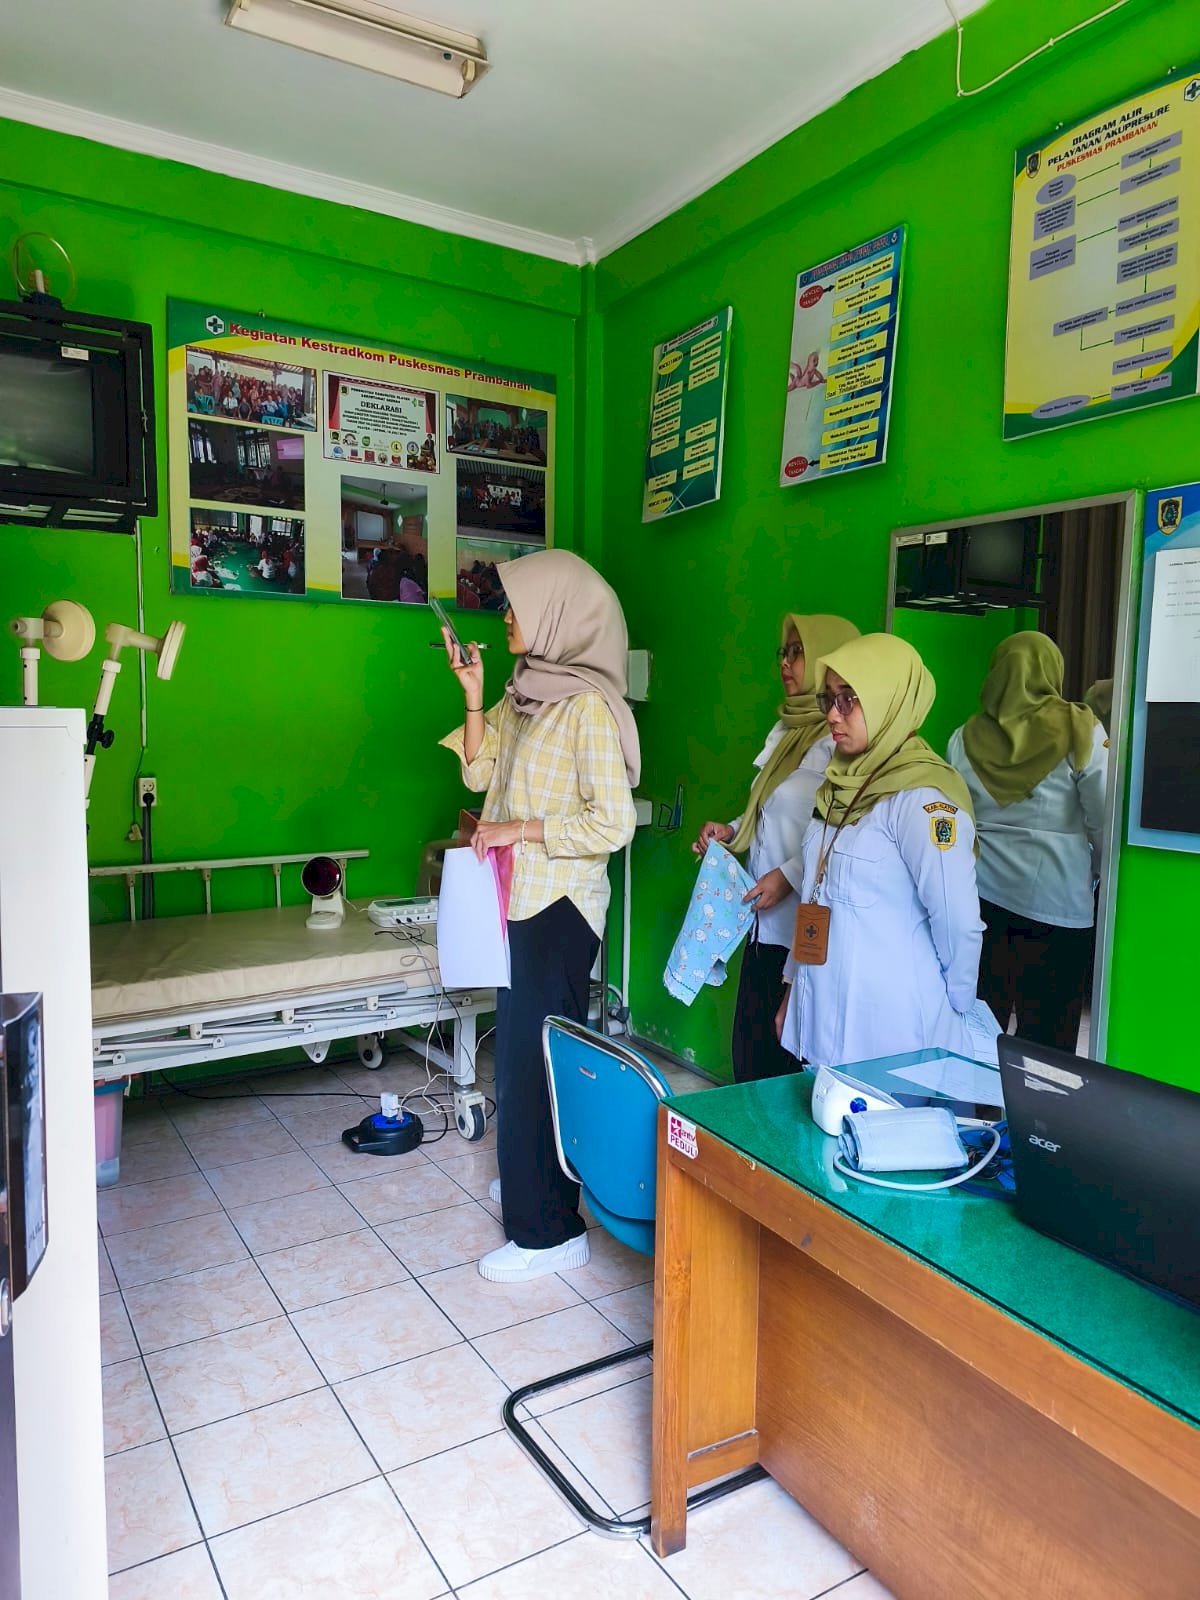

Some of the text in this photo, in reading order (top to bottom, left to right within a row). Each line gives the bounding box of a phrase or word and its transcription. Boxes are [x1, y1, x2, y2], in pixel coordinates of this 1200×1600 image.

[1048, 138, 1102, 167] PELAYANAN
[1104, 104, 1170, 141] AKUPRESURE
[1056, 143, 1103, 172] PUSKESMAS
[1105, 120, 1159, 150] PRAMBANAN
[1072, 106, 1143, 146] DIAGRAM ALIR
[229, 321, 532, 391] Kegiatan Kestradkom Puskesmas Prambanan
[360, 401, 402, 414] DEKLARASI
[1028, 1134, 1062, 1153] acer
